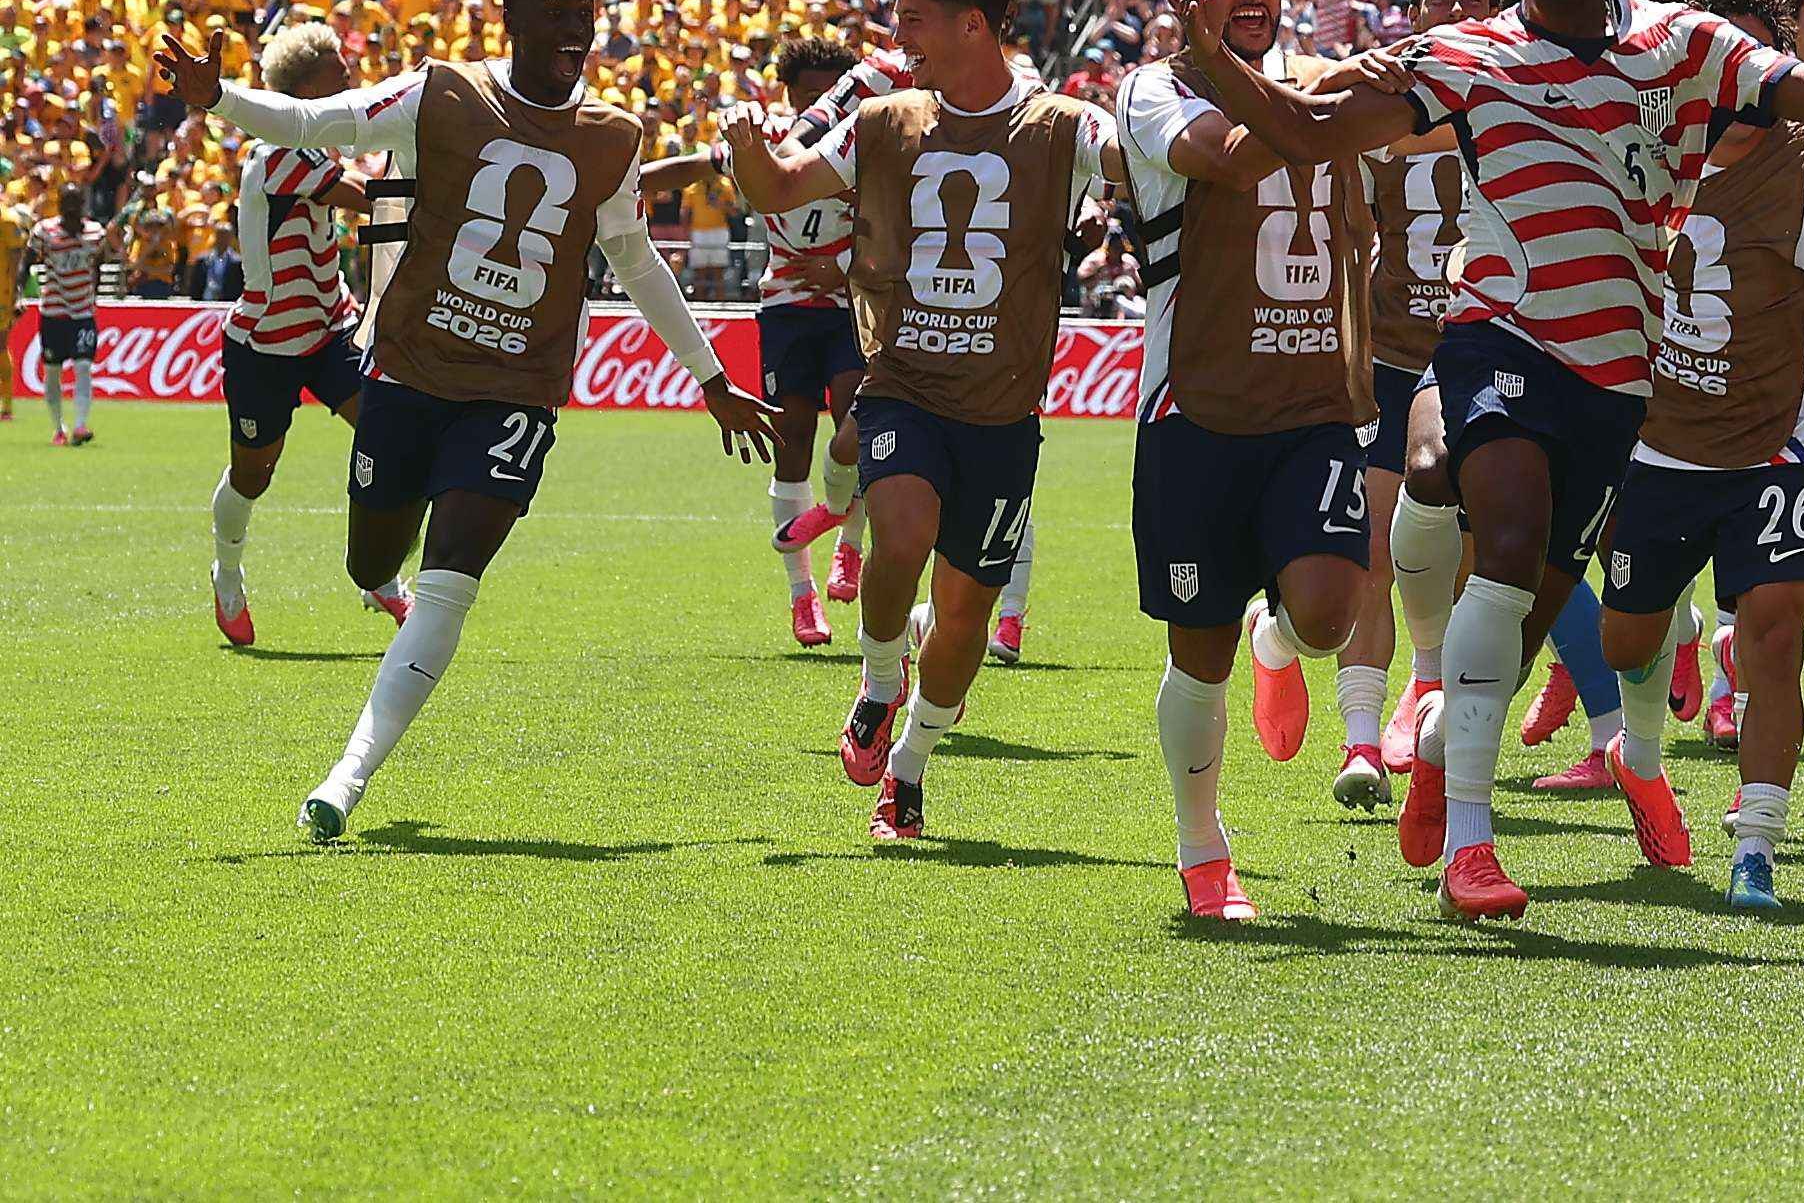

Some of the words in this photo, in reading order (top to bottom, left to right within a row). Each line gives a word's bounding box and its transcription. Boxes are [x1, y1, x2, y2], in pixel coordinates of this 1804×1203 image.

[1640, 88, 1670, 109] USA
[802, 209, 823, 245] 4
[473, 264, 521, 294] FIFA
[932, 276, 976, 295] FIFA
[1285, 264, 1320, 284] FIFA
[435, 288, 498, 323] WORLD
[500, 311, 533, 332] CUP
[902, 307, 965, 330] WORLD
[968, 314, 998, 330] CUP
[1253, 307, 1310, 325] WORLD
[1313, 308, 1334, 325] CUP
[426, 306, 528, 356] 2026
[895, 326, 995, 355] 2026
[1250, 326, 1339, 354] 2026
[1659, 342, 1692, 367] ORLD
[1694, 357, 1731, 374] CUP
[1497, 371, 1524, 385] USA
[1655, 356, 1727, 396] 026
[487, 411, 547, 470] 21
[873, 431, 895, 447] USA
[1319, 458, 1366, 521] 15
[982, 496, 1029, 550] 14
[1171, 565, 1197, 580] USA
[1612, 552, 1630, 567] USA
